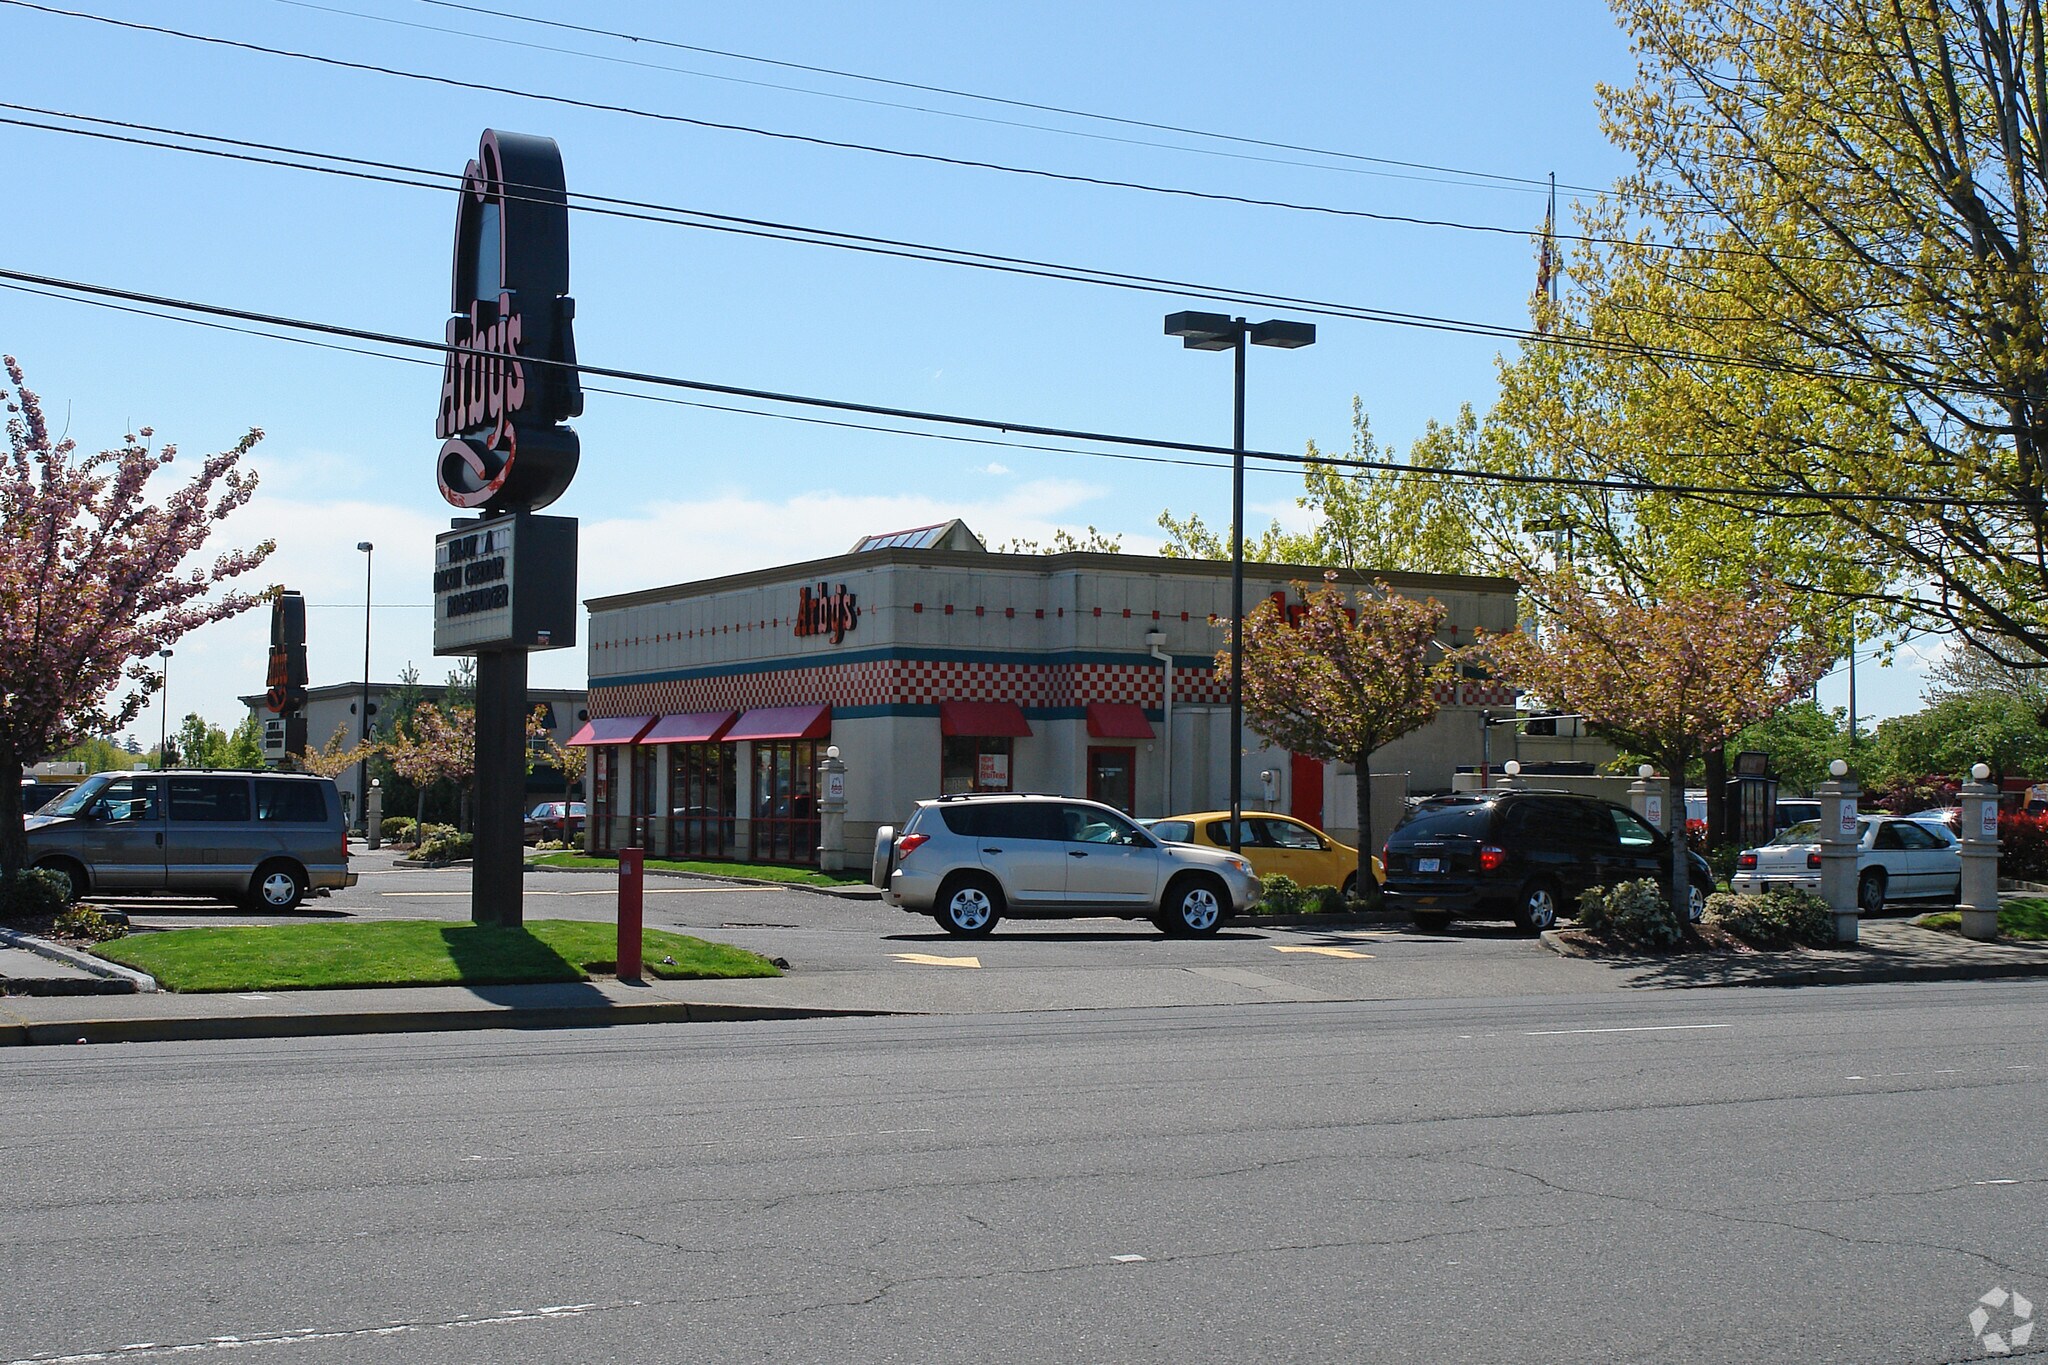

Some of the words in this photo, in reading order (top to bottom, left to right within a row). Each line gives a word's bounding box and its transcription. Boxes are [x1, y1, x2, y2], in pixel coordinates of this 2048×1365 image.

[436, 292, 525, 450] Arby's
[485, 530, 494, 554] A
[794, 582, 857, 645] Arby's
